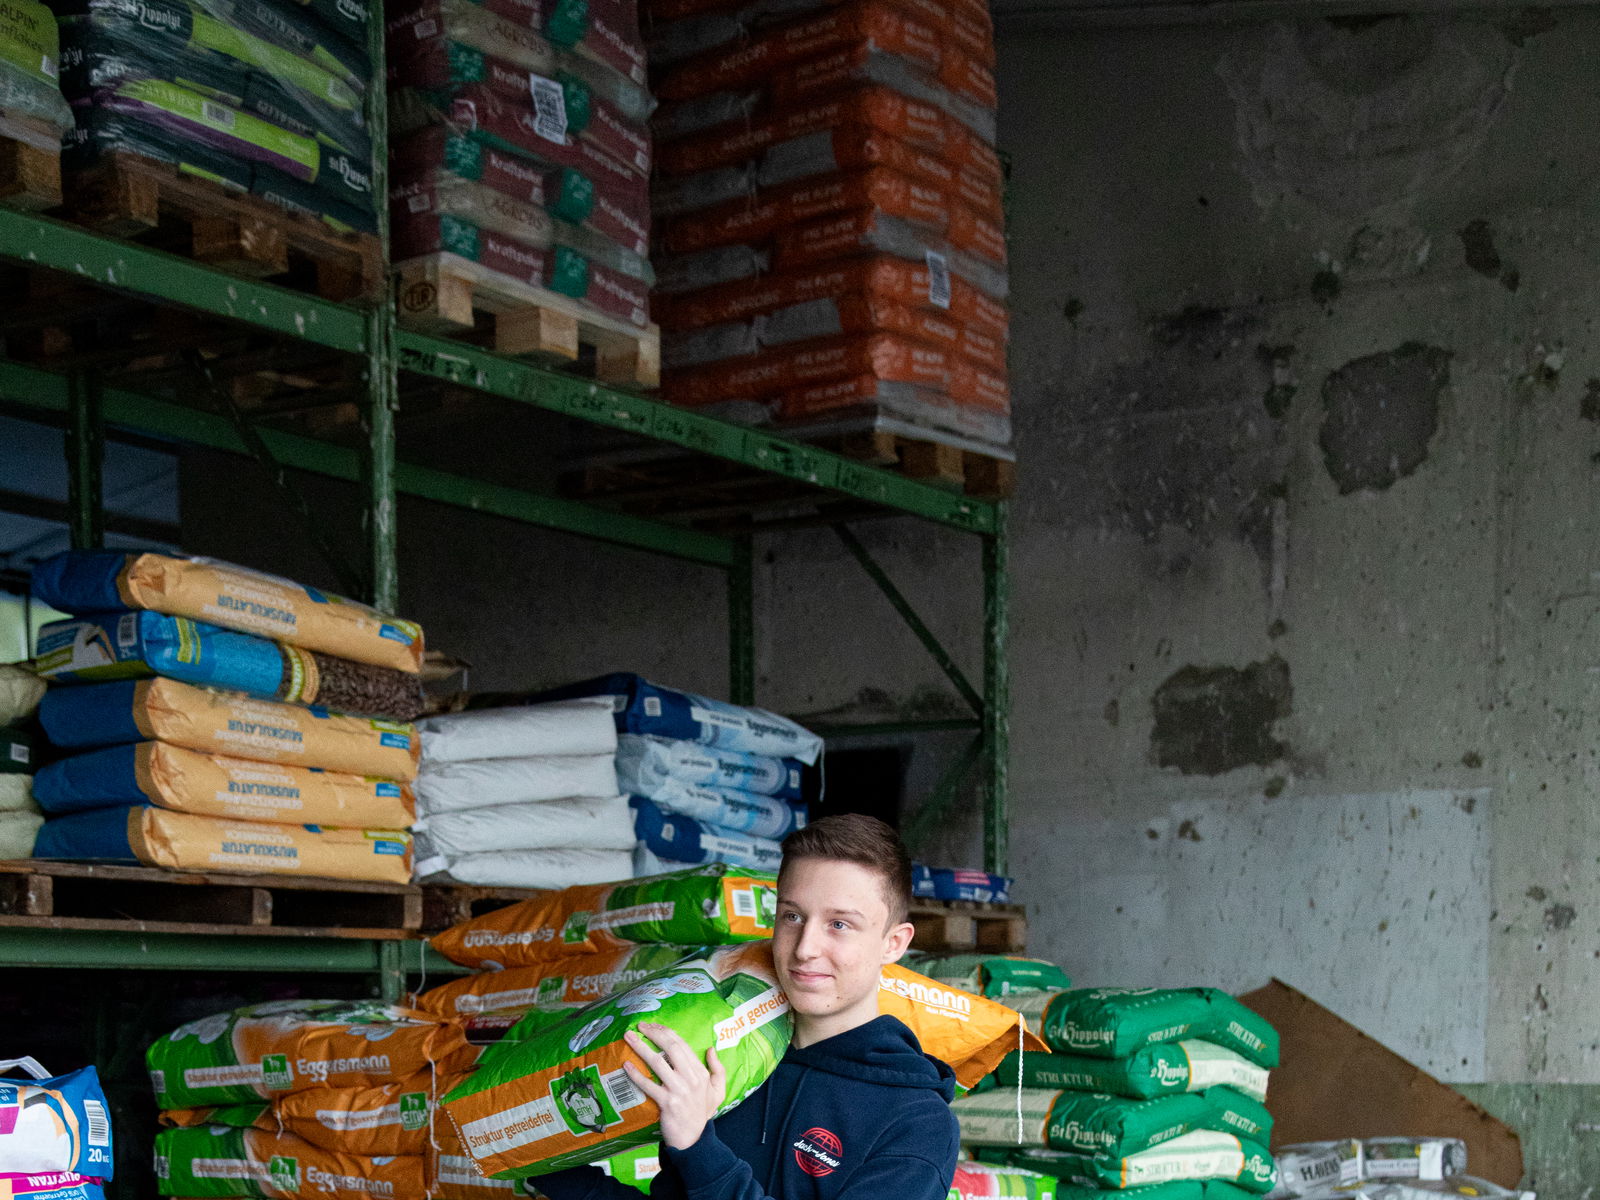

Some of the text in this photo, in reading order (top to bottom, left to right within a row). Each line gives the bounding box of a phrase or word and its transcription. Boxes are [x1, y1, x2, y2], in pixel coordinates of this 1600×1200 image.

[217, 592, 297, 626] MUSKULATUR
[227, 719, 303, 743] MUSKULATUR
[227, 780, 300, 799] MUSKULATUR
[221, 840, 298, 859] MUSKULATUR
[1062, 1021, 1115, 1048] Hippolyt
[296, 1054, 391, 1081] Eggersmann
[1035, 1071, 1093, 1087] STRUKTUR
[504, 1110, 555, 1141] getreidefrei
[88, 1148, 103, 1164] 20
[306, 1165, 394, 1194] Eggersmann
